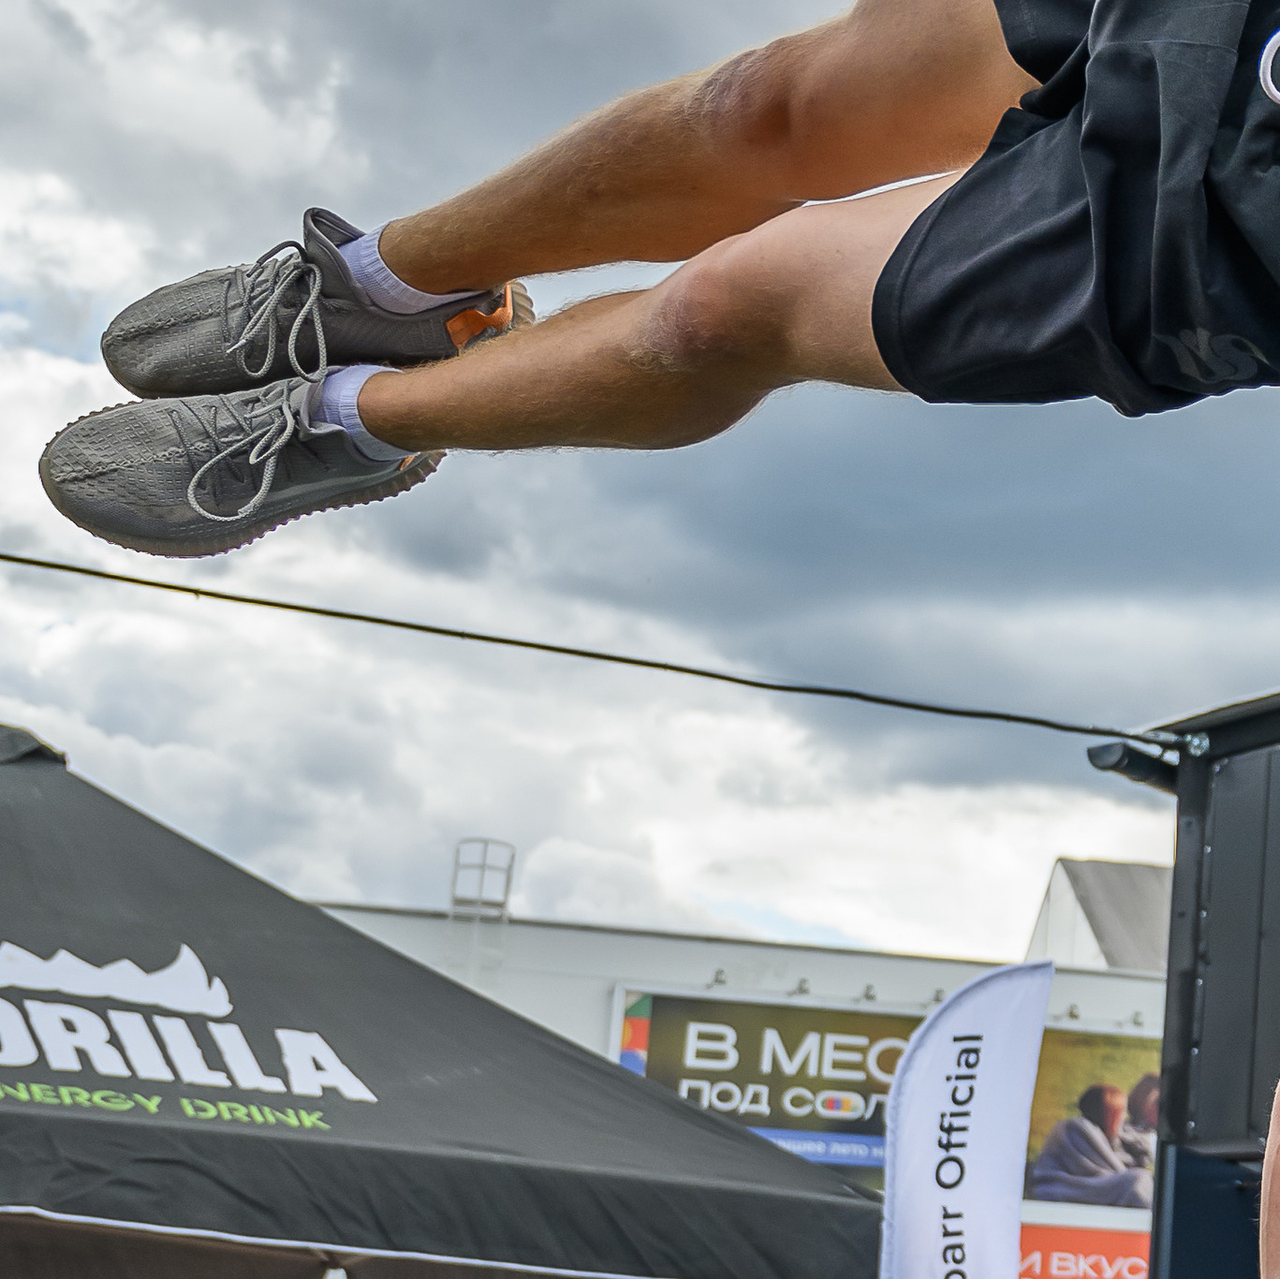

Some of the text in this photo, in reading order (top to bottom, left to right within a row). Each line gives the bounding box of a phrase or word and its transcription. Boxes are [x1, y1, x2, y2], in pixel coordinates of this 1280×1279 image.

[684, 1022, 908, 1085] В МЕС
[180, 1098, 331, 1130] DRINK
[678, 1078, 771, 1116] ПОД
[934, 1033, 984, 1190] Official
